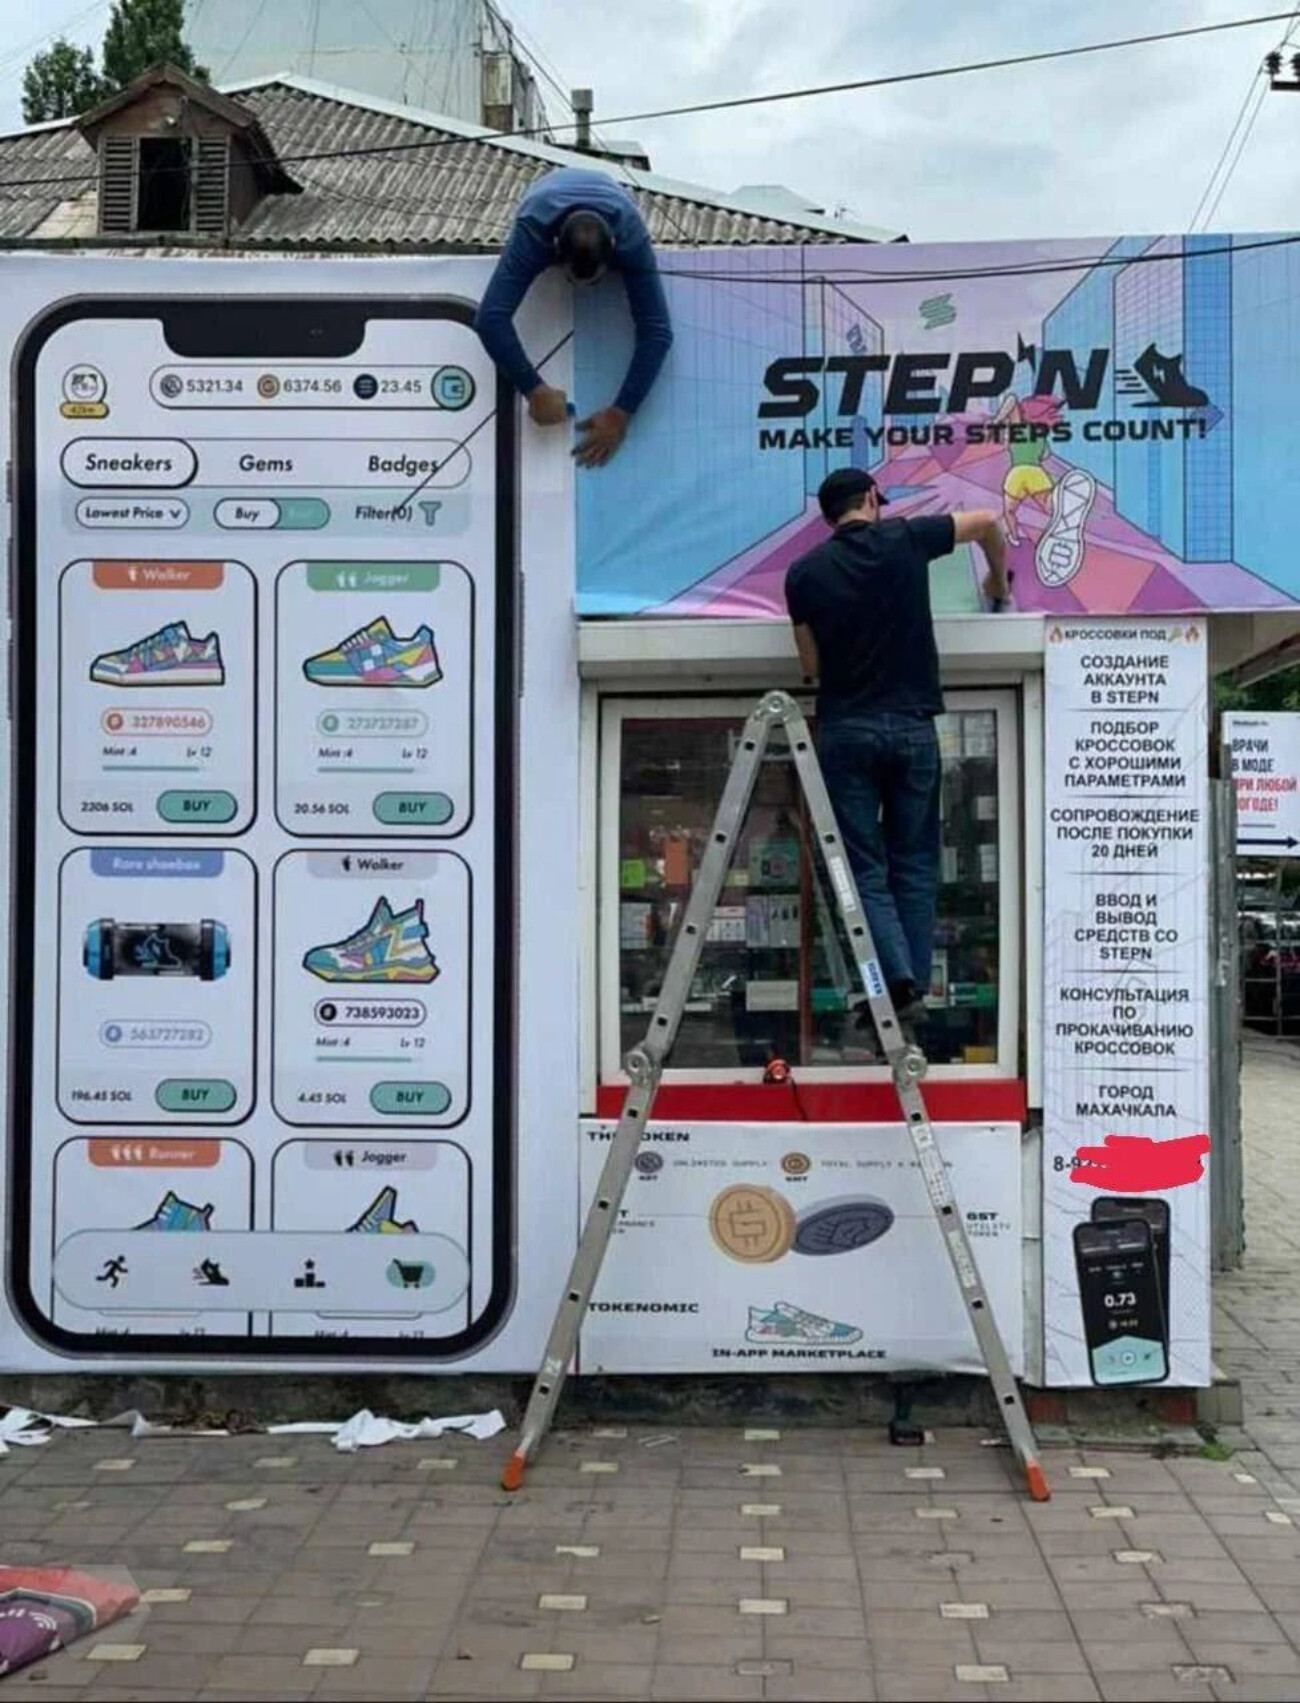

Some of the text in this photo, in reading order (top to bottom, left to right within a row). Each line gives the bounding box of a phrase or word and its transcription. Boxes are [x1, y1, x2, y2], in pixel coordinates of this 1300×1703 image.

[186, 379, 422, 393] 5321.34 6374.56 23.45
[758, 418, 1207, 450] MAKE YOUR STEPS COUNT!
[85, 453, 440, 477] Sneakers Gems Badges
[85, 506, 165, 519] Lowest Price
[235, 506, 260, 523] Buy
[355, 505, 413, 522] Filter(0)
[143, 568, 191, 581] Walker
[1065, 628, 1167, 641] КРОССОВКИ ПОД
[1080, 655, 1169, 670] СОЗДАНИЕ
[1084, 673, 1167, 686] АККАУНТА
[1091, 690, 1159, 704] В STEPN
[1091, 721, 1159, 736] ПОДБОР
[1075, 738, 1176, 752] КРОССОВОК
[1232, 738, 1269, 753] ВРАЧИ
[1069, 756, 1182, 770] С ХОРОШИМИ
[1241, 758, 1274, 773] МОДЕ
[1064, 774, 1186, 788] ПАРАМЕТРАМИ
[1256, 776, 1297, 792] ЛЮБОЙ
[183, 799, 212, 812] BUY
[398, 801, 427, 814] BUY
[1237, 797, 1279, 812] ОГОДЕ!
[1050, 808, 1200, 825] СОПРОВОЖДЕНИЕ
[1058, 827, 1193, 841] ПОСЛЕ ПОКУПКИ
[1091, 843, 1159, 859] 20 ДНЕЙ
[357, 858, 405, 870] Walker
[1095, 893, 1158, 909] ВВОД И
[1095, 911, 1158, 927] ВЫВОД
[1074, 929, 1179, 945] СРЕДСТВ СО
[1099, 946, 1153, 961] STEPN
[1060, 988, 1190, 1004] КОНСУЛЬТАЦИЯ
[345, 1006, 421, 1020] 738593023
[1112, 1006, 1137, 1020] ПО
[1056, 1023, 1194, 1038] ПРОКАЧИВАНИЮ
[1074, 1041, 1176, 1056] КРОССОВОК
[181, 1087, 210, 1101] BUY
[396, 1091, 425, 1104] BUY
[1099, 1085, 1154, 1100] ГОРОД
[1075, 1103, 1178, 1118] МАХАЧКАЛА
[587, 1131, 690, 1142] TH OKEN
[149, 1146, 196, 1161] Runner
[361, 1150, 407, 1166] Jogger
[1104, 1292, 1137, 1308] 0.73
[712, 1348, 887, 1360] IN-APP MARKETPLACE
